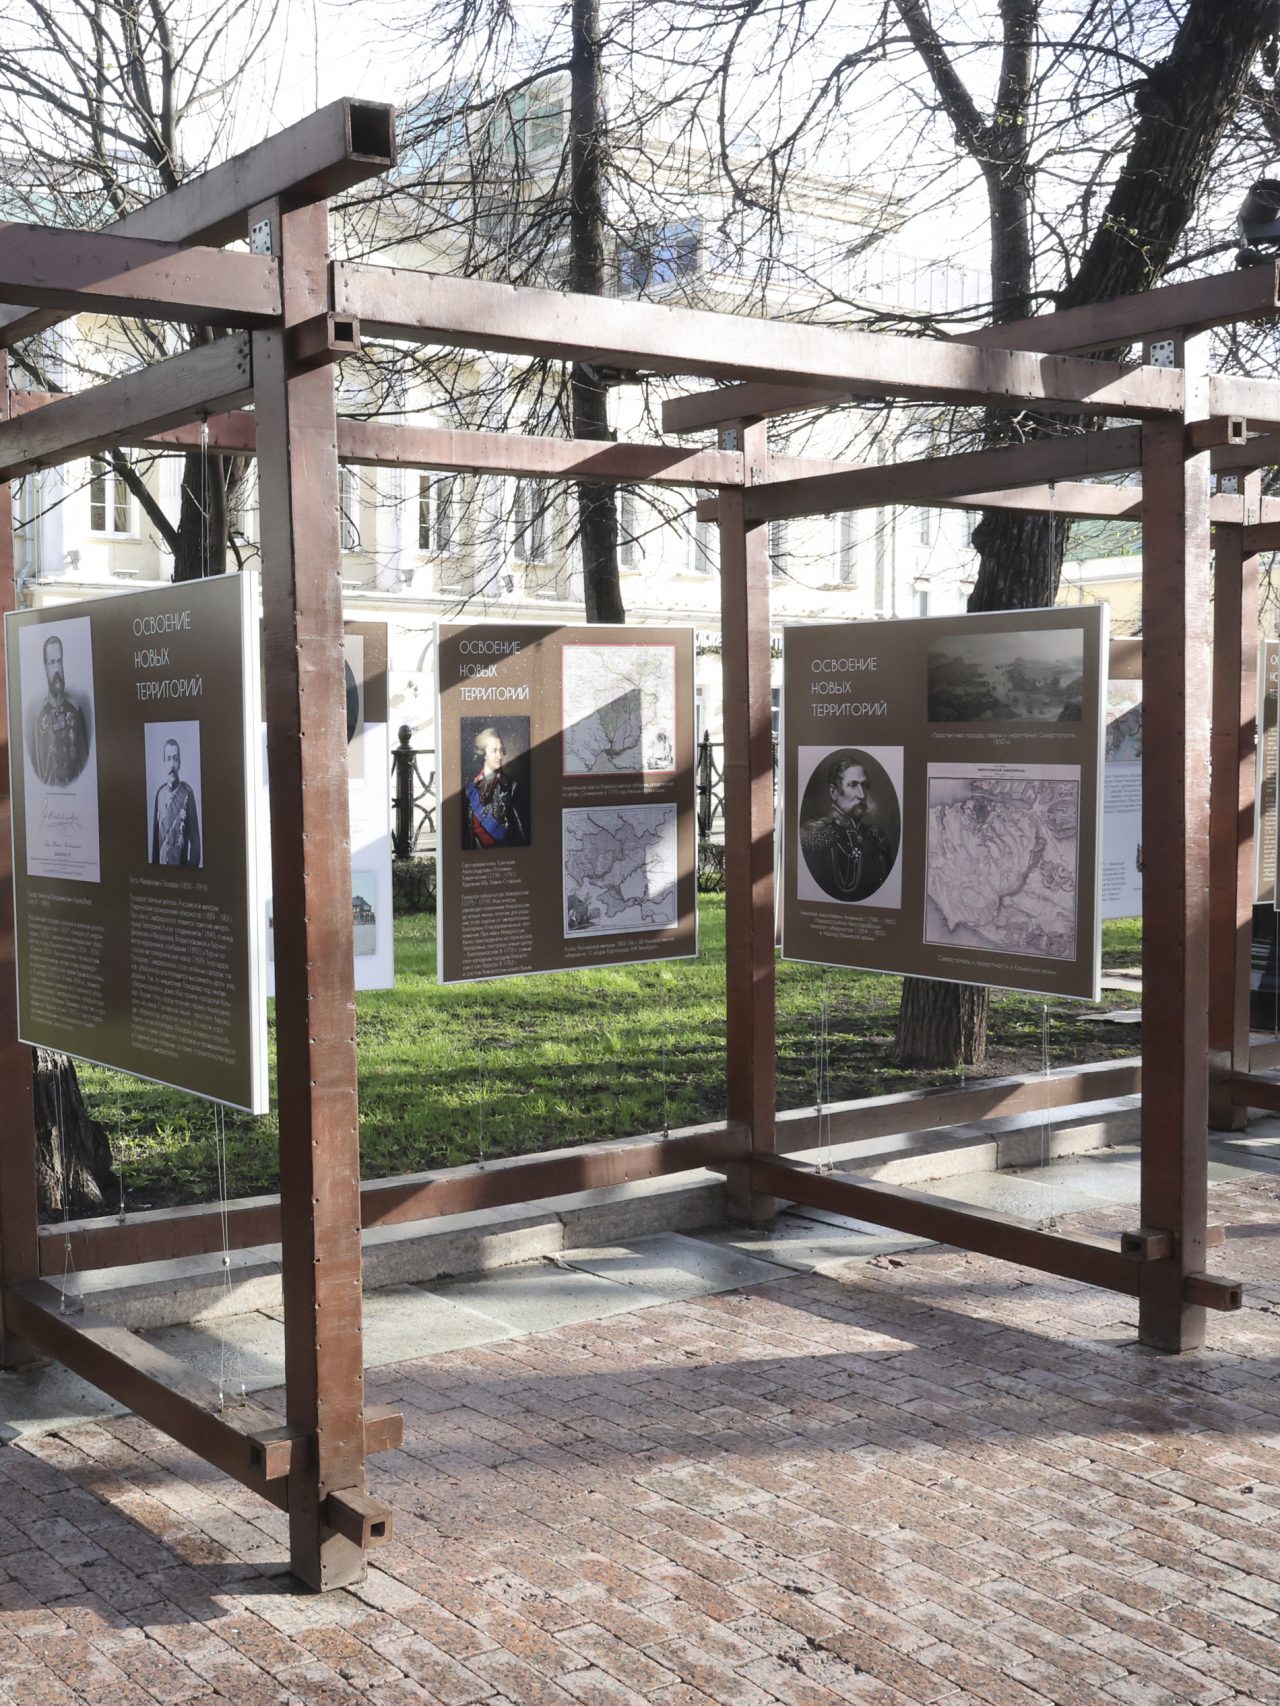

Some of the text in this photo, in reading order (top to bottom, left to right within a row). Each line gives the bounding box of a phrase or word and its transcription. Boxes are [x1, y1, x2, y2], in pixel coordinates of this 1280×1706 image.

[133, 610, 192, 637] ОСВОЕНИЕ
[459, 640, 521, 655] ОСВОЕНИЕ
[134, 647, 170, 669] НОВЫХ
[811, 656, 877, 673] ОСВОЕНИЕ
[459, 663, 498, 678] НОВЫХ
[134, 673, 204, 701] ТЕРРИТОРИЙ
[459, 684, 530, 701] ТЕРРИТОРИЙ
[811, 681, 852, 695] НОВЫХ
[811, 700, 888, 717] ТЕРРИТОРИЙ
